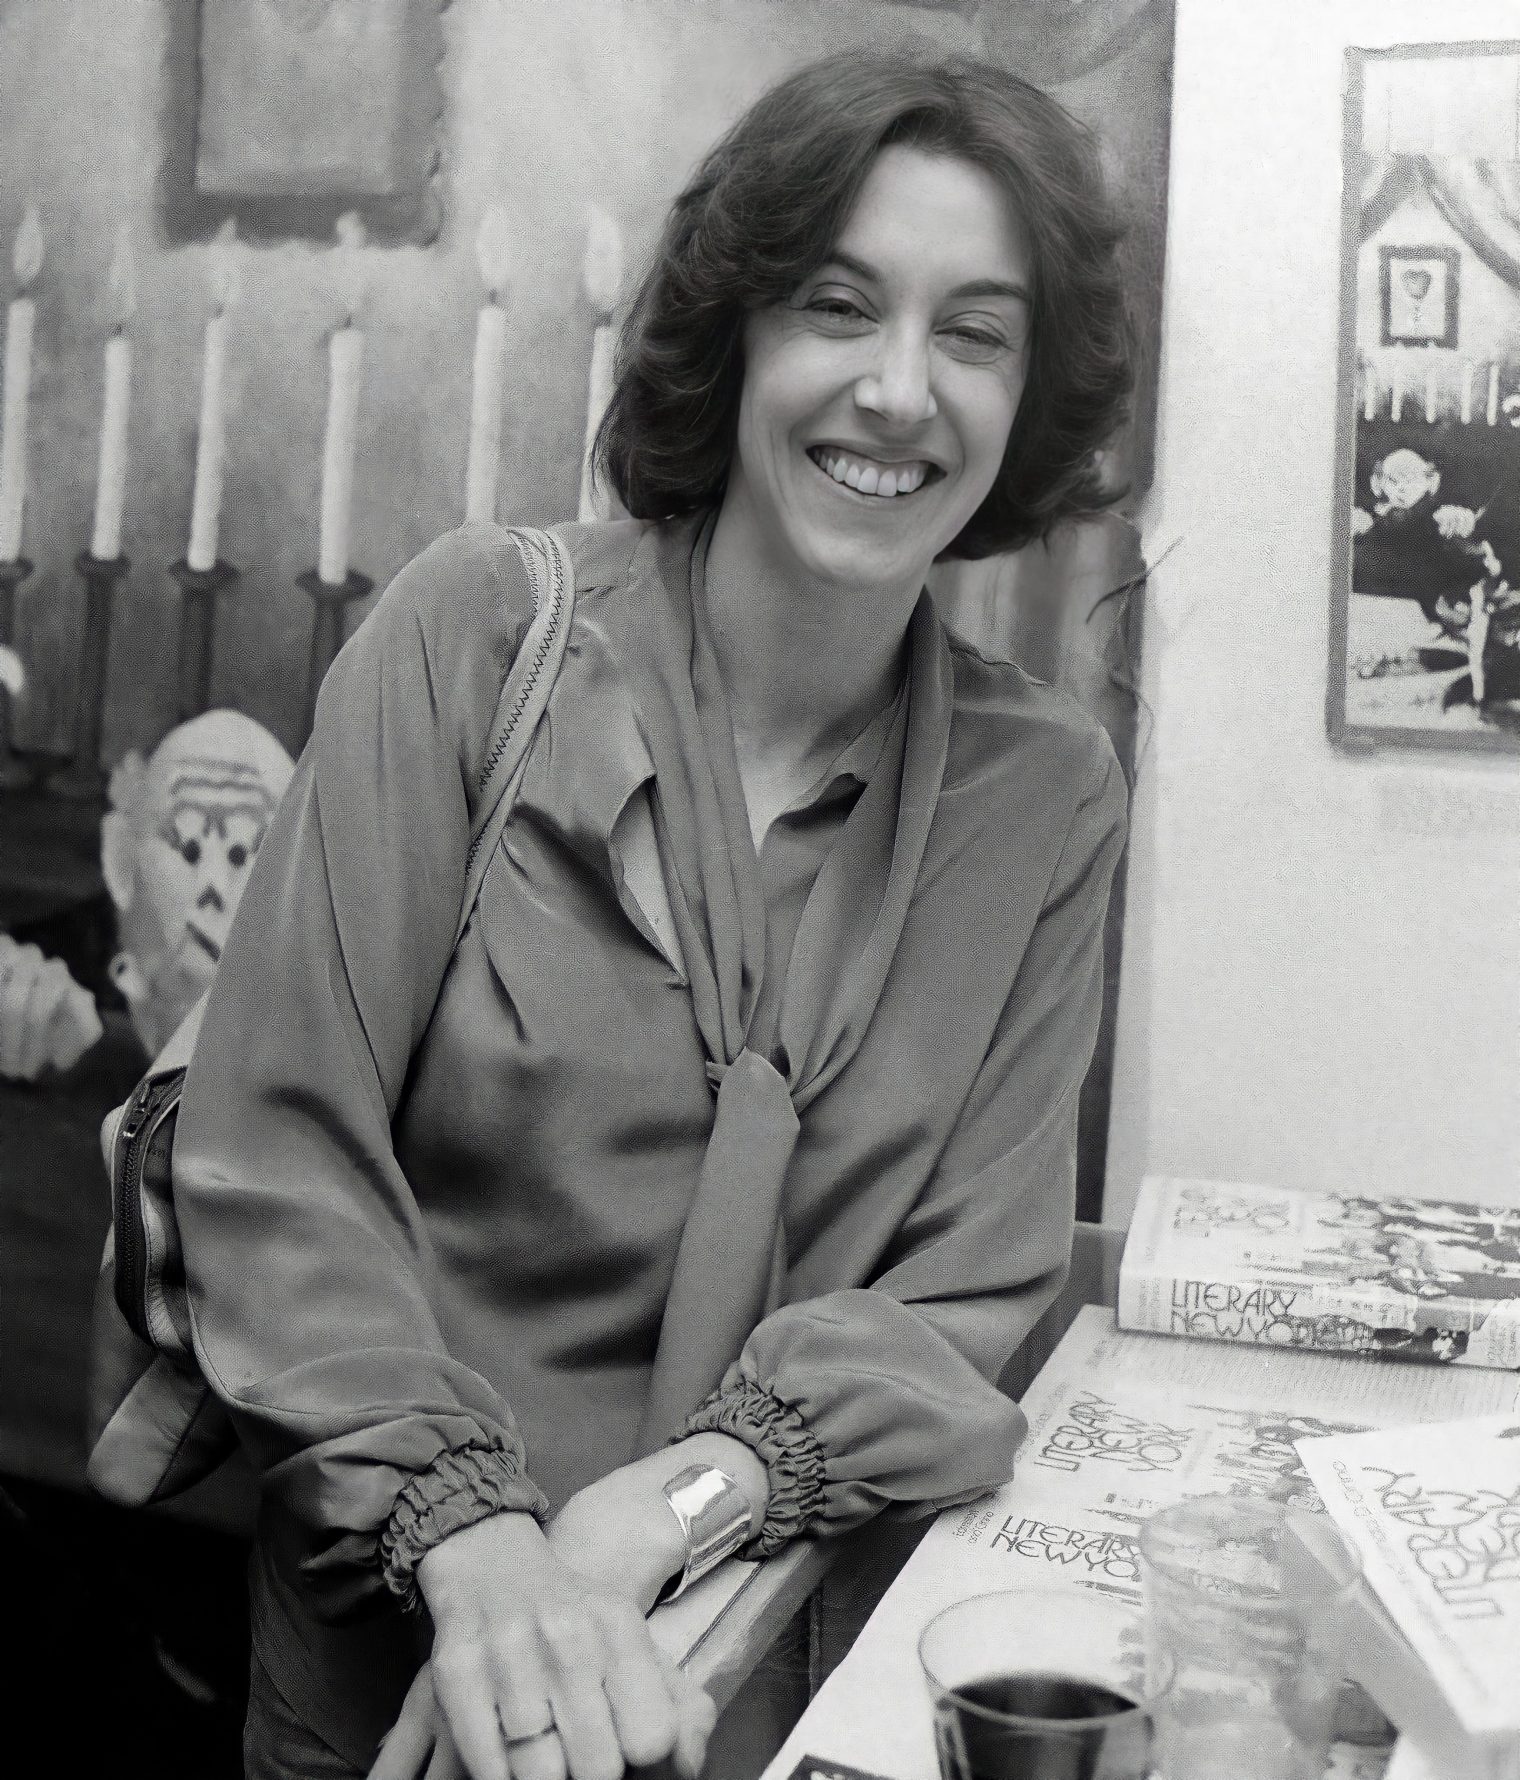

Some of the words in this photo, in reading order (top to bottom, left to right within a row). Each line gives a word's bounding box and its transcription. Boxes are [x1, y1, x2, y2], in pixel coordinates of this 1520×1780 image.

[1171, 1279, 1298, 1318] LITERARY
[1170, 1310, 1244, 1338] NEW
[1033, 1390, 1117, 1473] LITERARY
[989, 1531, 1083, 1566] NEW
[1001, 1514, 1142, 1561] LITERARY
[1360, 1465, 1504, 1620] LITERARY
